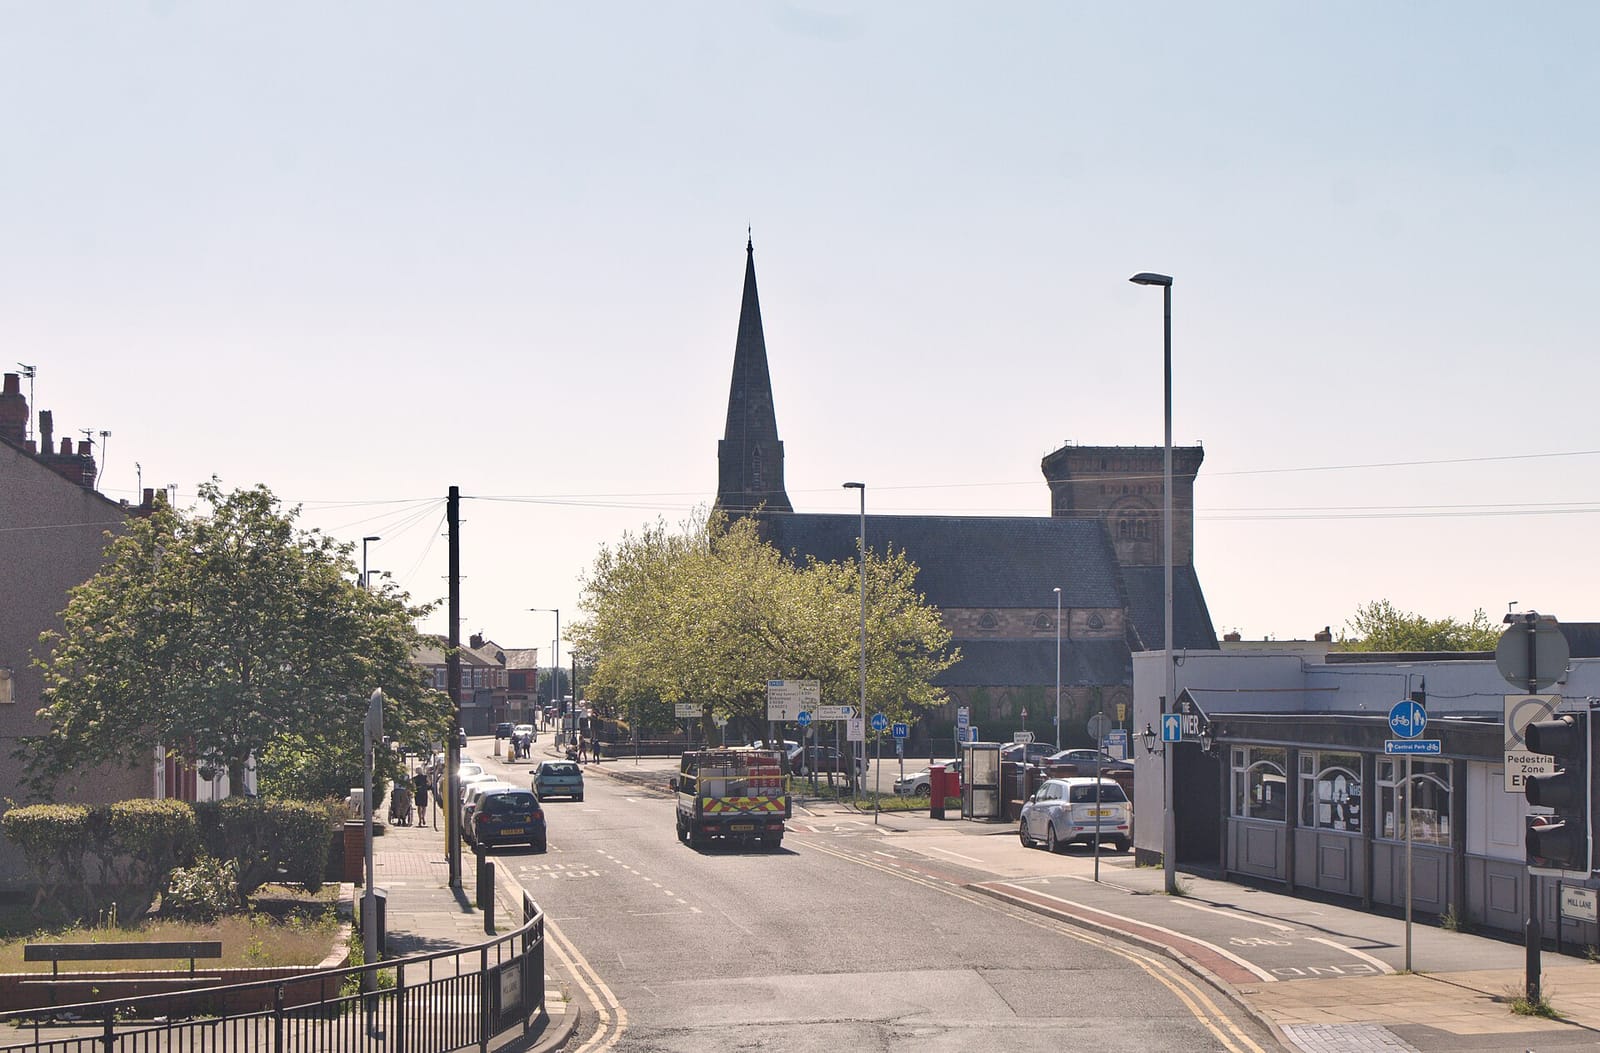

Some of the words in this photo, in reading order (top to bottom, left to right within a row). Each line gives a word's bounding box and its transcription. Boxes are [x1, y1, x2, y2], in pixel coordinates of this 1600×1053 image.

[896, 726, 905, 735] IN
[1182, 714, 1199, 735] WER
[1507, 755, 1553, 764] Pedestria
[1521, 764, 1545, 773] Zone
[1512, 774, 1529, 786] EN
[1567, 897, 1578, 907] MILL
[1578, 898, 1592, 910] LANE
[1270, 964, 1378, 976] END
